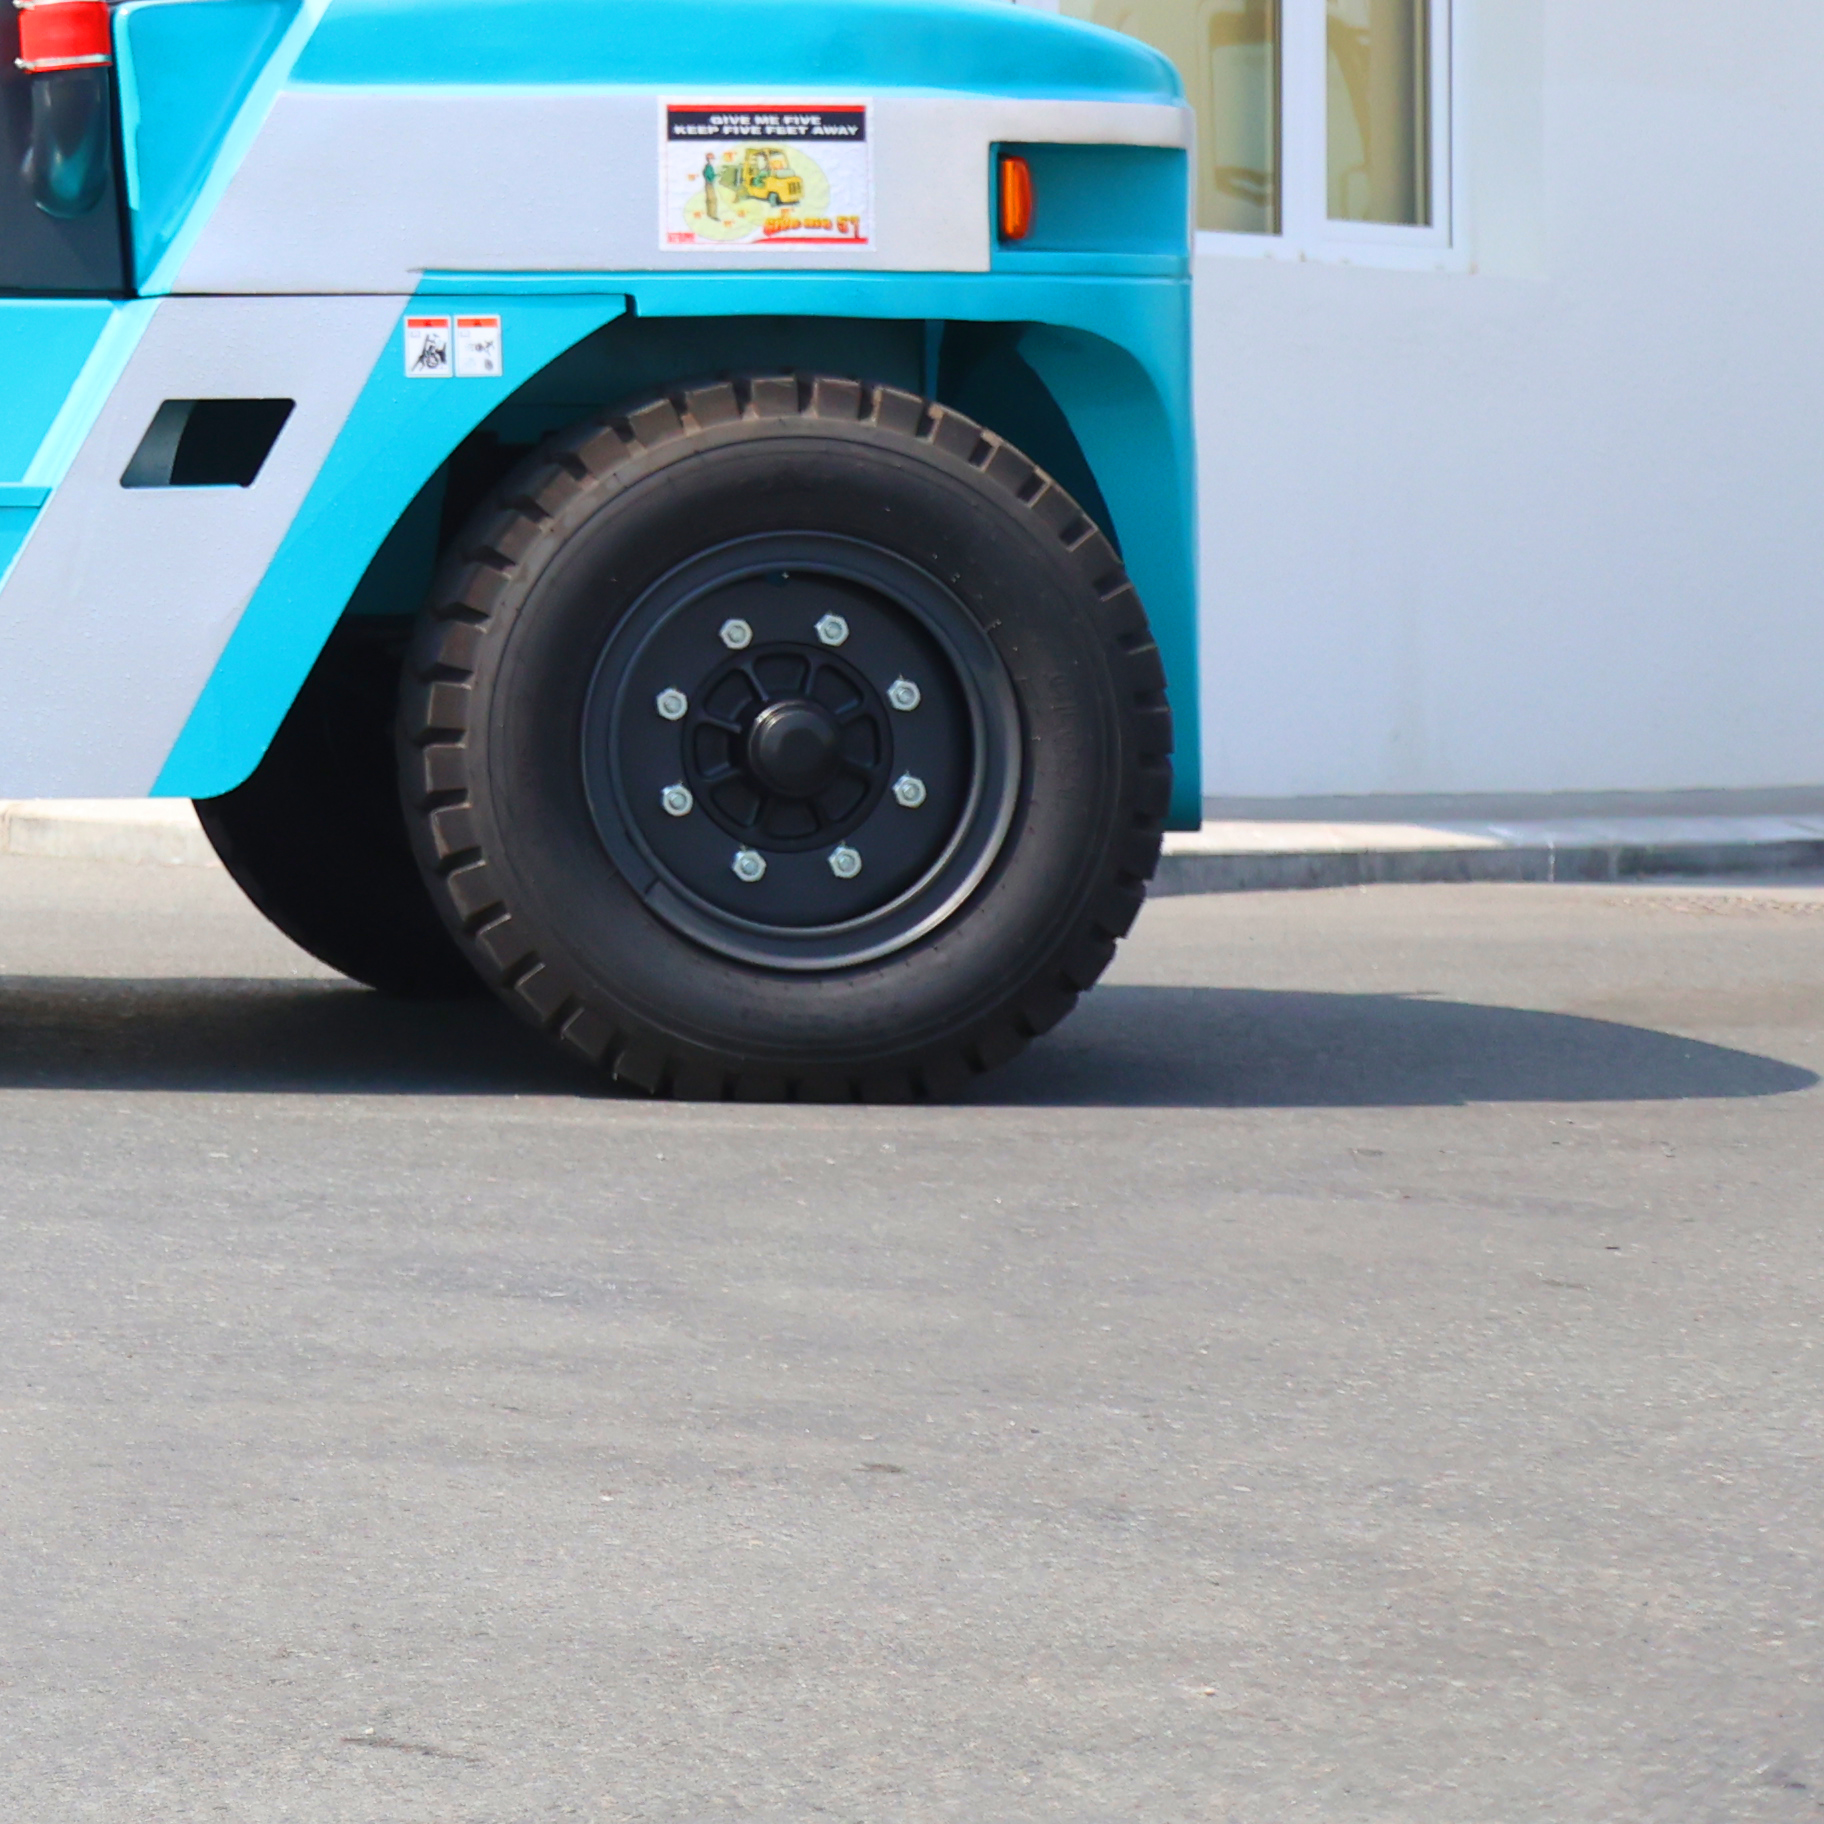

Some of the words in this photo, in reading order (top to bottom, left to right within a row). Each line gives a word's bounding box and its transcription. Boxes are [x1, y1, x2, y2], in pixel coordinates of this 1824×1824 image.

[710, 114, 751, 126] GIVE
[754, 114, 780, 126] ME
[783, 114, 822, 126] FIVE
[673, 125, 720, 135] KEEP
[723, 125, 762, 136] FIVE
[765, 125, 809, 136] FEET
[811, 125, 859, 136] AWAY
